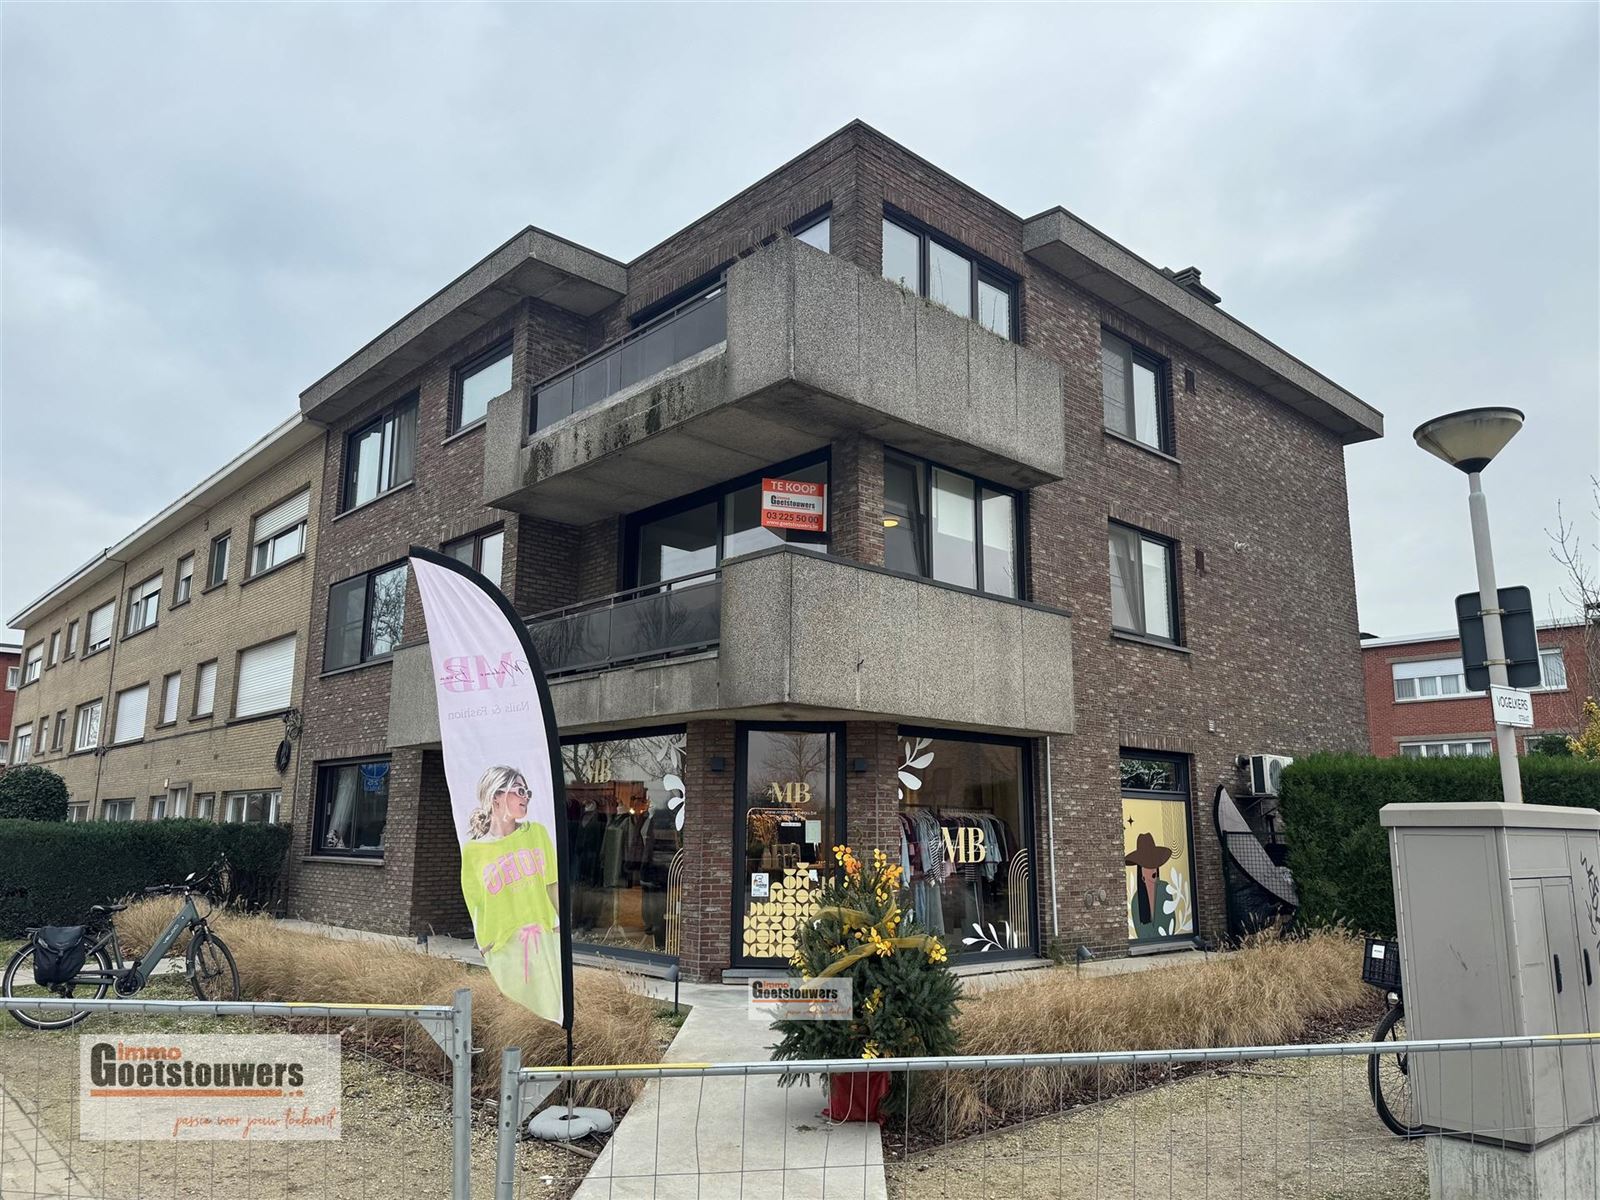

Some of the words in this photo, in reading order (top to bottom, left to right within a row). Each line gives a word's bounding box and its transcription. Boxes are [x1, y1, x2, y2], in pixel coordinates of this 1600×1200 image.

[771, 481, 784, 490] TE
[785, 483, 816, 494] KOOP
[771, 495, 816, 509] Goetstouwers
[766, 511, 777, 520] 03
[778, 513, 794, 521] 225
[796, 514, 807, 522] 50
[808, 516, 819, 524] 00
[1496, 695, 1529, 711] VOGELKERS
[771, 782, 811, 804] MB
[940, 827, 987, 864] MB
